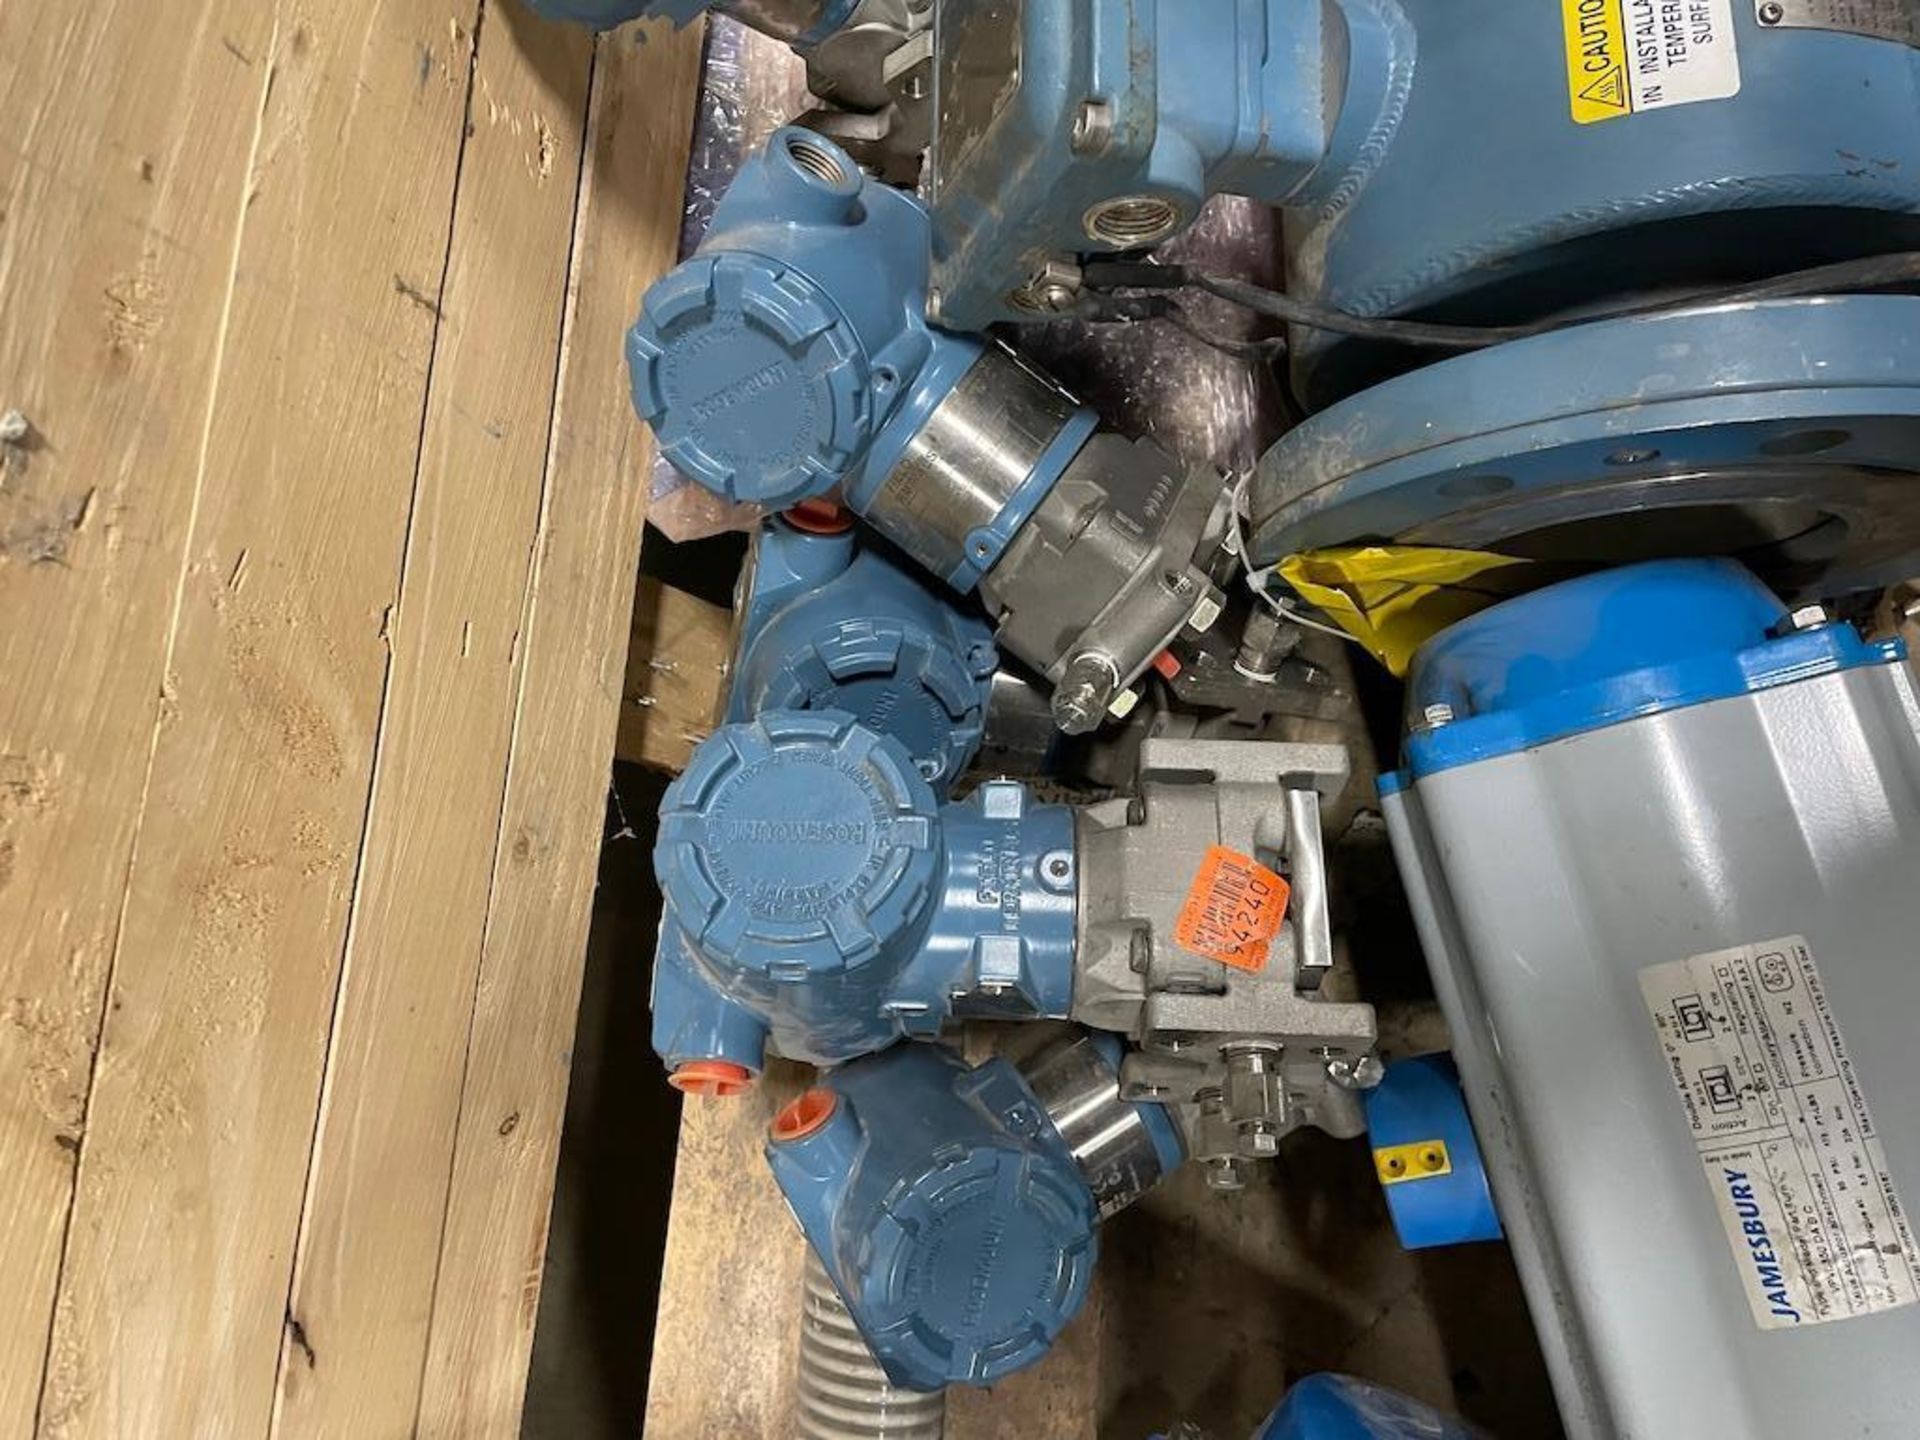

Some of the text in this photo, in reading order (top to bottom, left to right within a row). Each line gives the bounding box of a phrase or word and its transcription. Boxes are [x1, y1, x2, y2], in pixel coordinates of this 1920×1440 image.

[1579, 0, 1609, 72] CAUTIO
[1662, 0, 1686, 67] TEMPER
[1689, 0, 1713, 45] SURF
[1642, 85, 1663, 104] IN
[727, 820, 866, 844] ROSEMOUNT
[1790, 1034, 1810, 1077] Pressure
[1724, 1168, 1800, 1322] JAMESBURY
